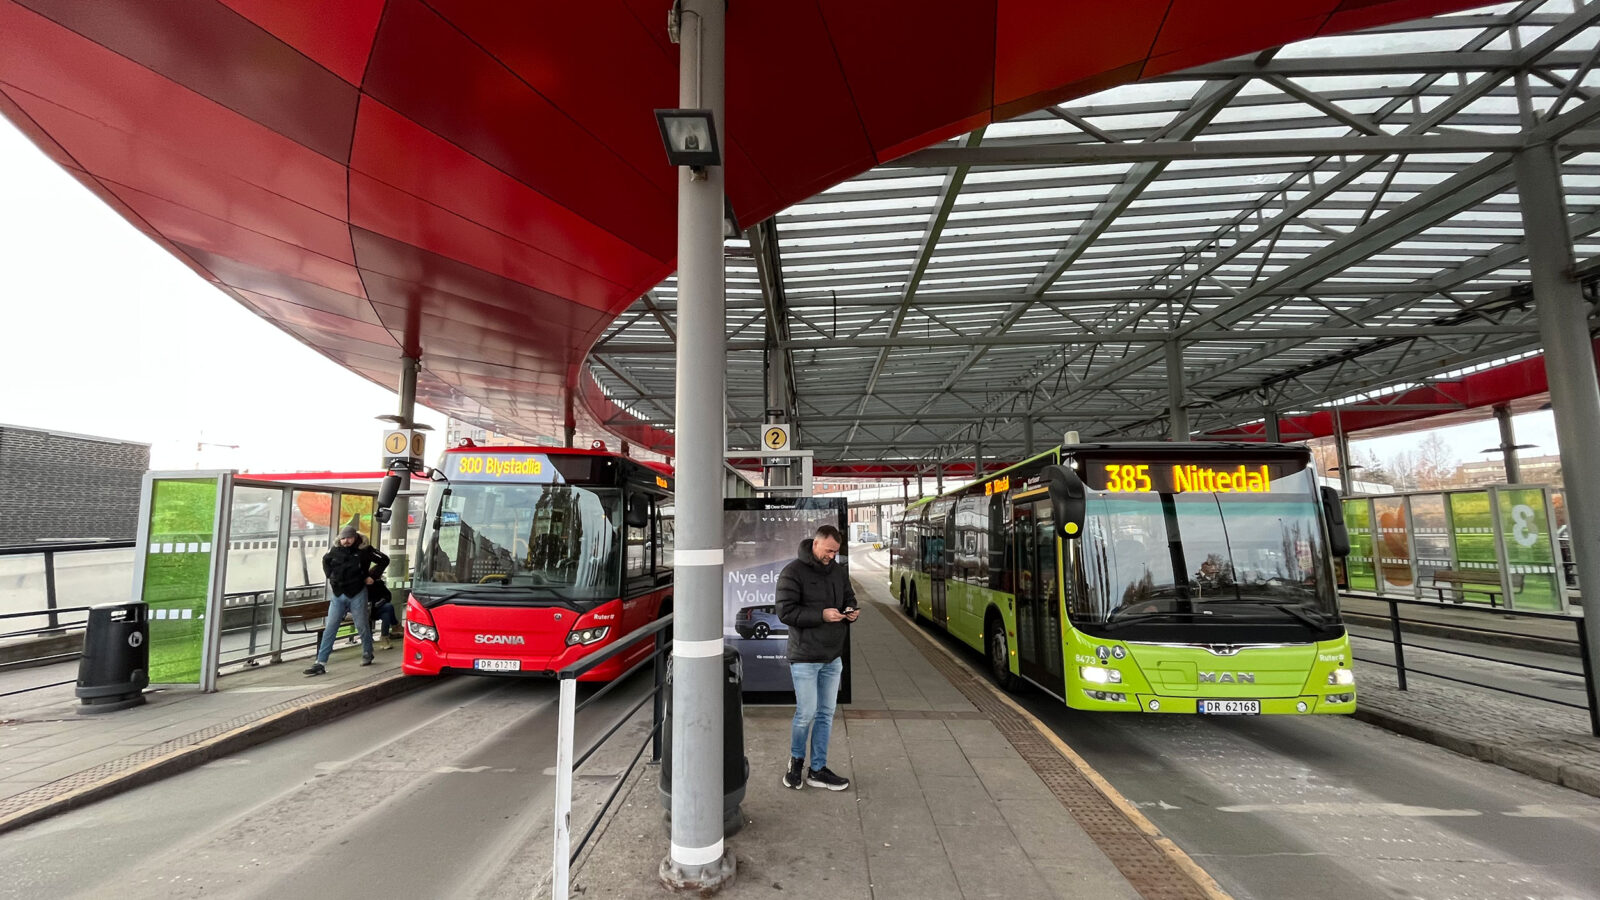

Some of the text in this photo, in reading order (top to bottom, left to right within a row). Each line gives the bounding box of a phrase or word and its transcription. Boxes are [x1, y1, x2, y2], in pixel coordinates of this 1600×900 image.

[393, 436, 399, 450] 1
[771, 431, 780, 445] 2
[459, 456, 542, 478] 300 Blystadlia
[1104, 464, 1271, 493] 385 Nittedal
[728, 570, 757, 587] Nye
[736, 589, 776, 603] Volvo
[474, 634, 526, 645] SCANIA
[481, 660, 518, 670] DR 61218
[1075, 653, 1097, 665] 8473
[1199, 671, 1255, 684] MAN
[1206, 701, 1257, 712] DR 62168
